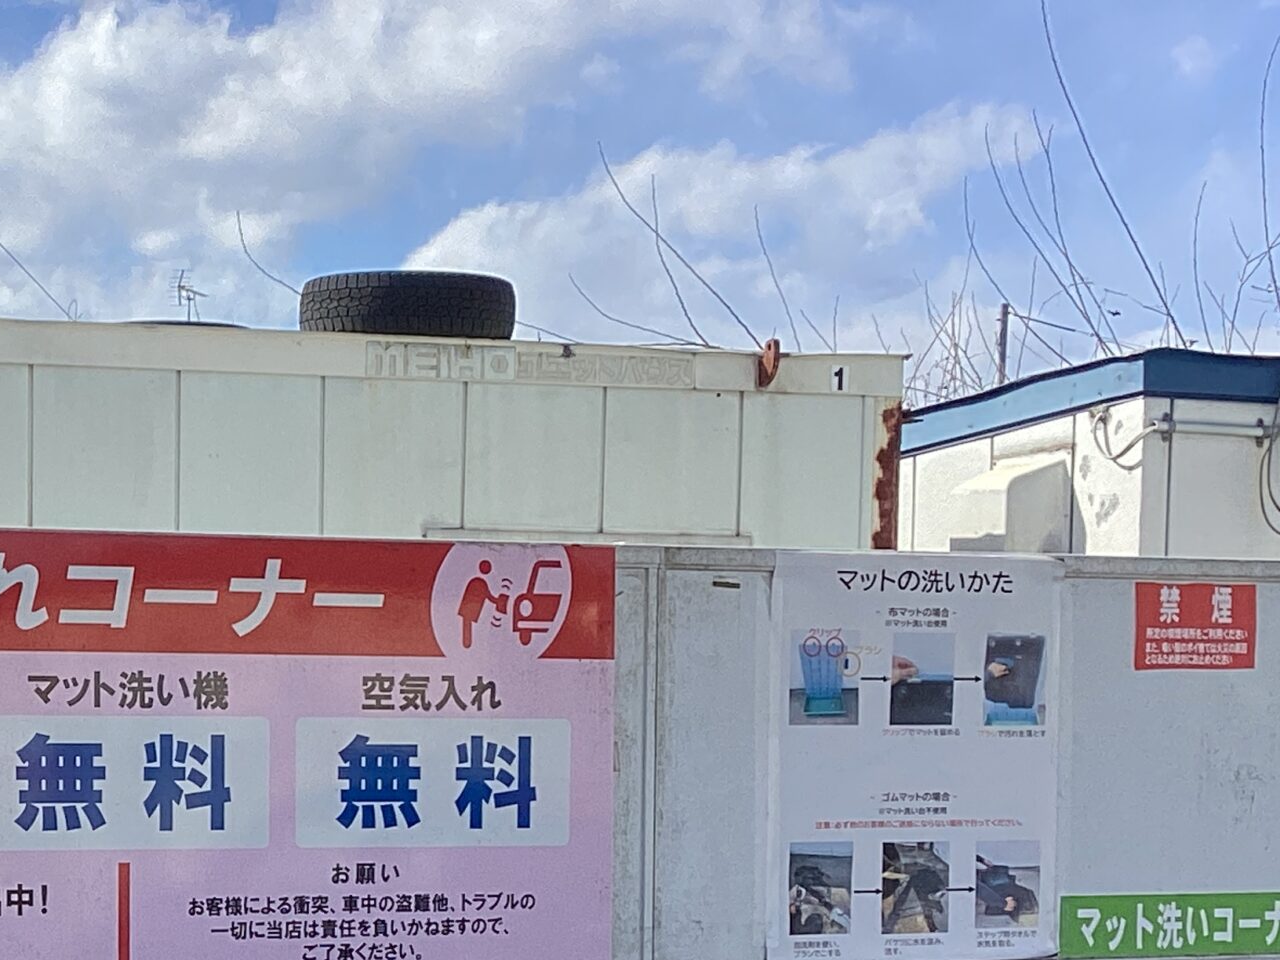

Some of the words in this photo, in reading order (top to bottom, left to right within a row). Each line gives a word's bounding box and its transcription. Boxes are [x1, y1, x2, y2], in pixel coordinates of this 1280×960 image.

[832, 366, 847, 391] 1
[836, 569, 1014, 594] マットの洗いかた
[27, 672, 230, 710] マット洗い機
[361, 673, 503, 712] 空気入れ
[330, 862, 402, 885] お願い
[187, 892, 536, 916] お客様による衝突、車中の盗難他、トラブルの
[209, 918, 512, 940] 一切に当店は責任を負いかねますので、
